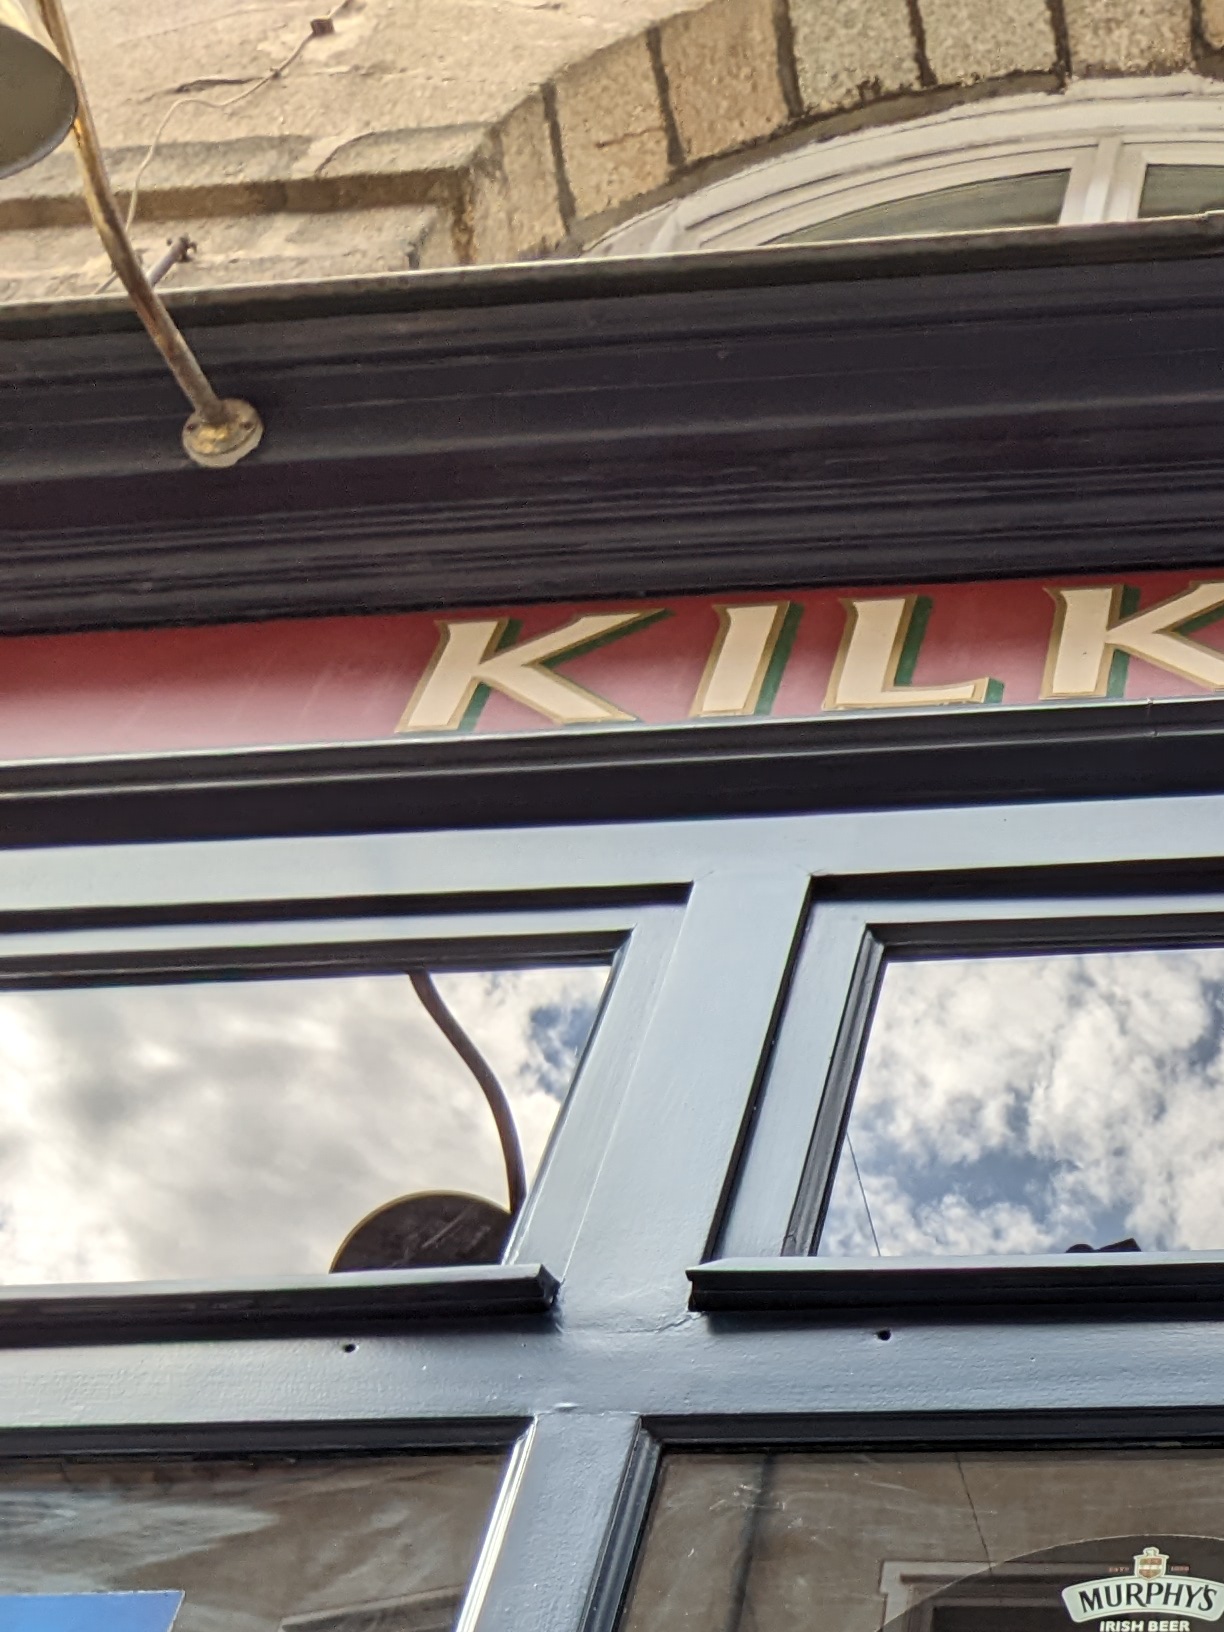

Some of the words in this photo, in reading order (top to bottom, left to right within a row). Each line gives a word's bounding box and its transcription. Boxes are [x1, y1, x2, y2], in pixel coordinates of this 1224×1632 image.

[1079, 1582, 1217, 1614] MURPHY'S
[1099, 1620, 1144, 1632] IRISH
[1147, 1620, 1191, 1632] BEER
